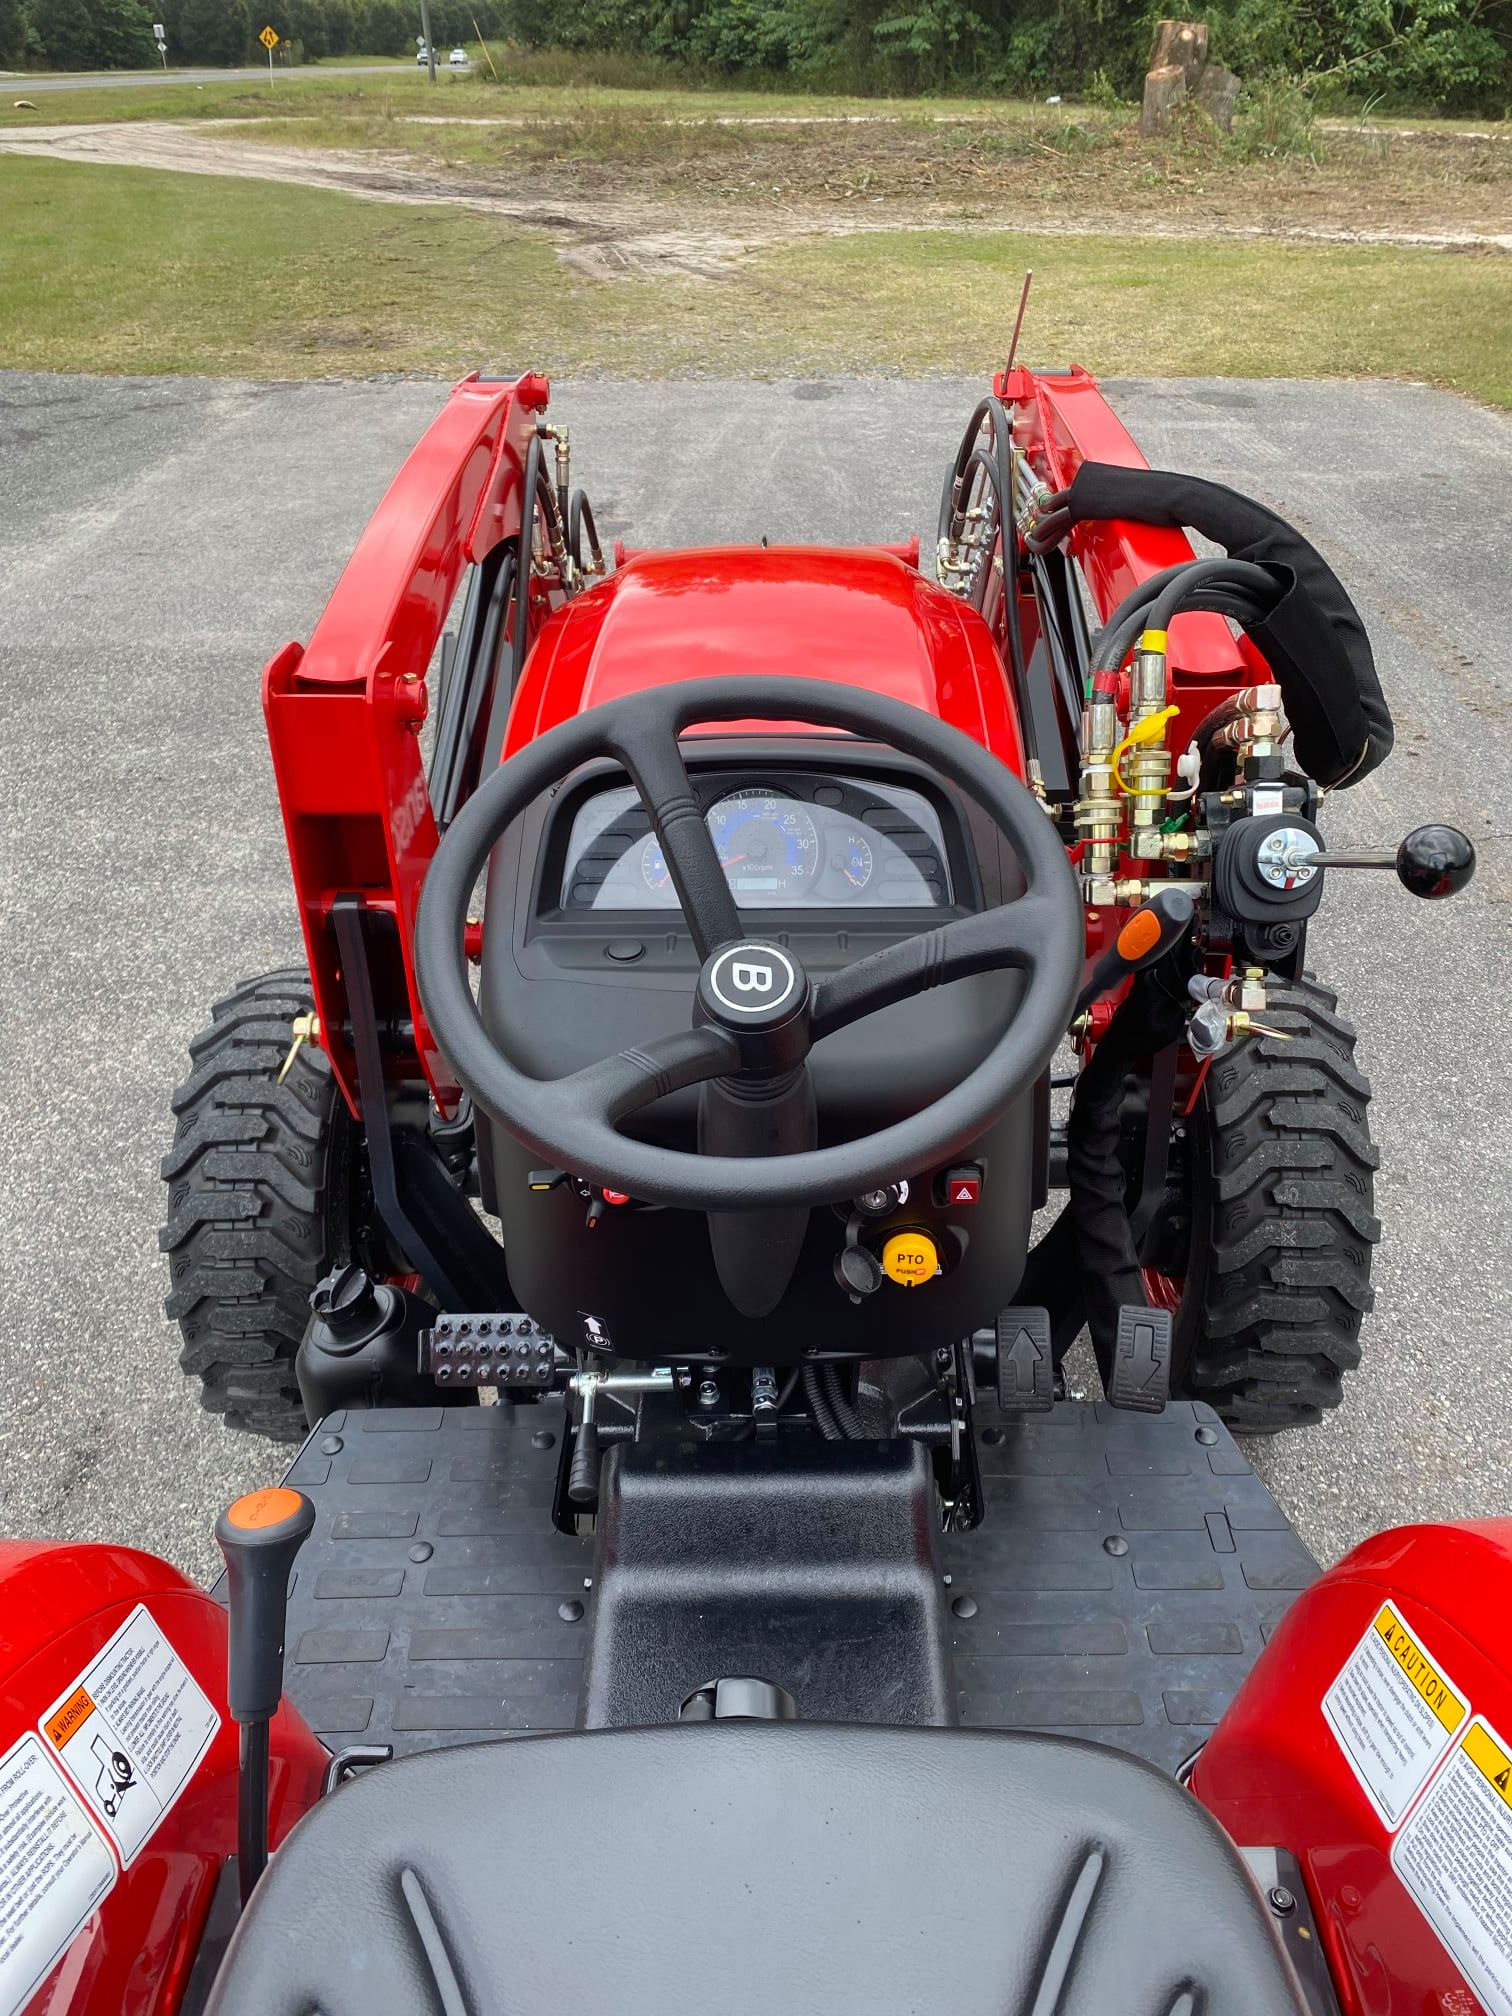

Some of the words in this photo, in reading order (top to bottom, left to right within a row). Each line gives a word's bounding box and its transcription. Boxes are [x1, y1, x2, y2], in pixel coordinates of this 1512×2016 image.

[737, 800, 748, 810] 15
[764, 800, 776, 810] 20
[716, 816, 726, 825] 10
[784, 815, 796, 824] 25
[796, 839, 809, 848] 30
[848, 836, 856, 844] H
[791, 866, 804, 875] 35
[732, 962, 772, 992] B
[898, 1254, 924, 1264] PTO
[1392, 1632, 1447, 1712] CAUTION
[57, 1692, 89, 1735] WARNING
[1474, 1773, 1498, 1809] PERSONAL
